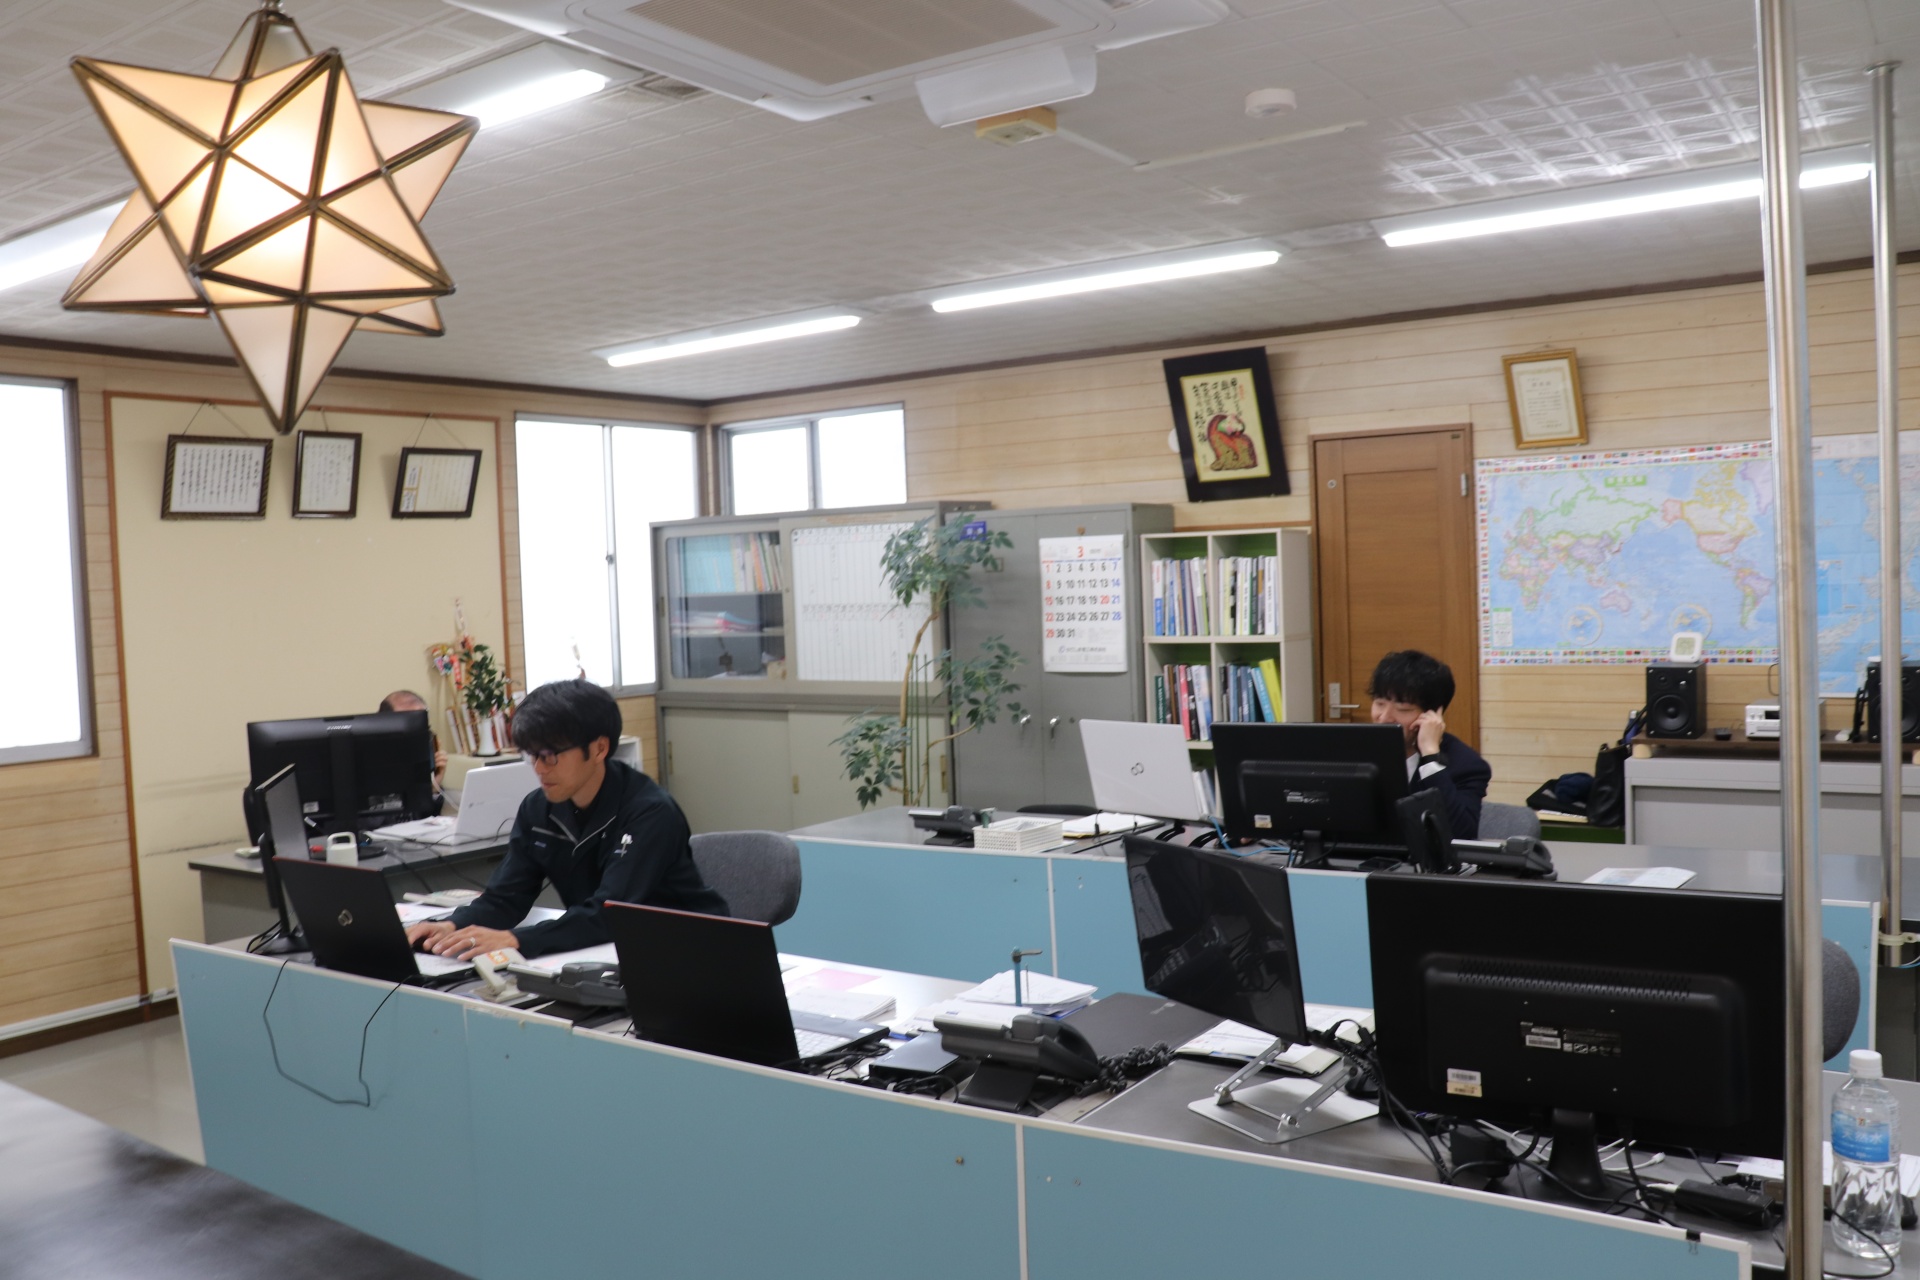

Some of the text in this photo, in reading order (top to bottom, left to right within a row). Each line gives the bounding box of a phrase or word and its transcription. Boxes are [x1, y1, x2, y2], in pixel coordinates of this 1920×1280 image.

[1077, 546, 1084, 558] 3
[1046, 561, 1118, 573] 1 2 3 4 5 6 7
[1046, 578, 1120, 590] 8 9 10 11 12 13 14
[1045, 595, 1120, 605] 15 16 17 18 19 20 21
[1045, 611, 1121, 622] 22 23 24 25 26 27 28
[1046, 628, 1075, 638] 29 30 31
[1841, 1130, 1883, 1144] 天然水
